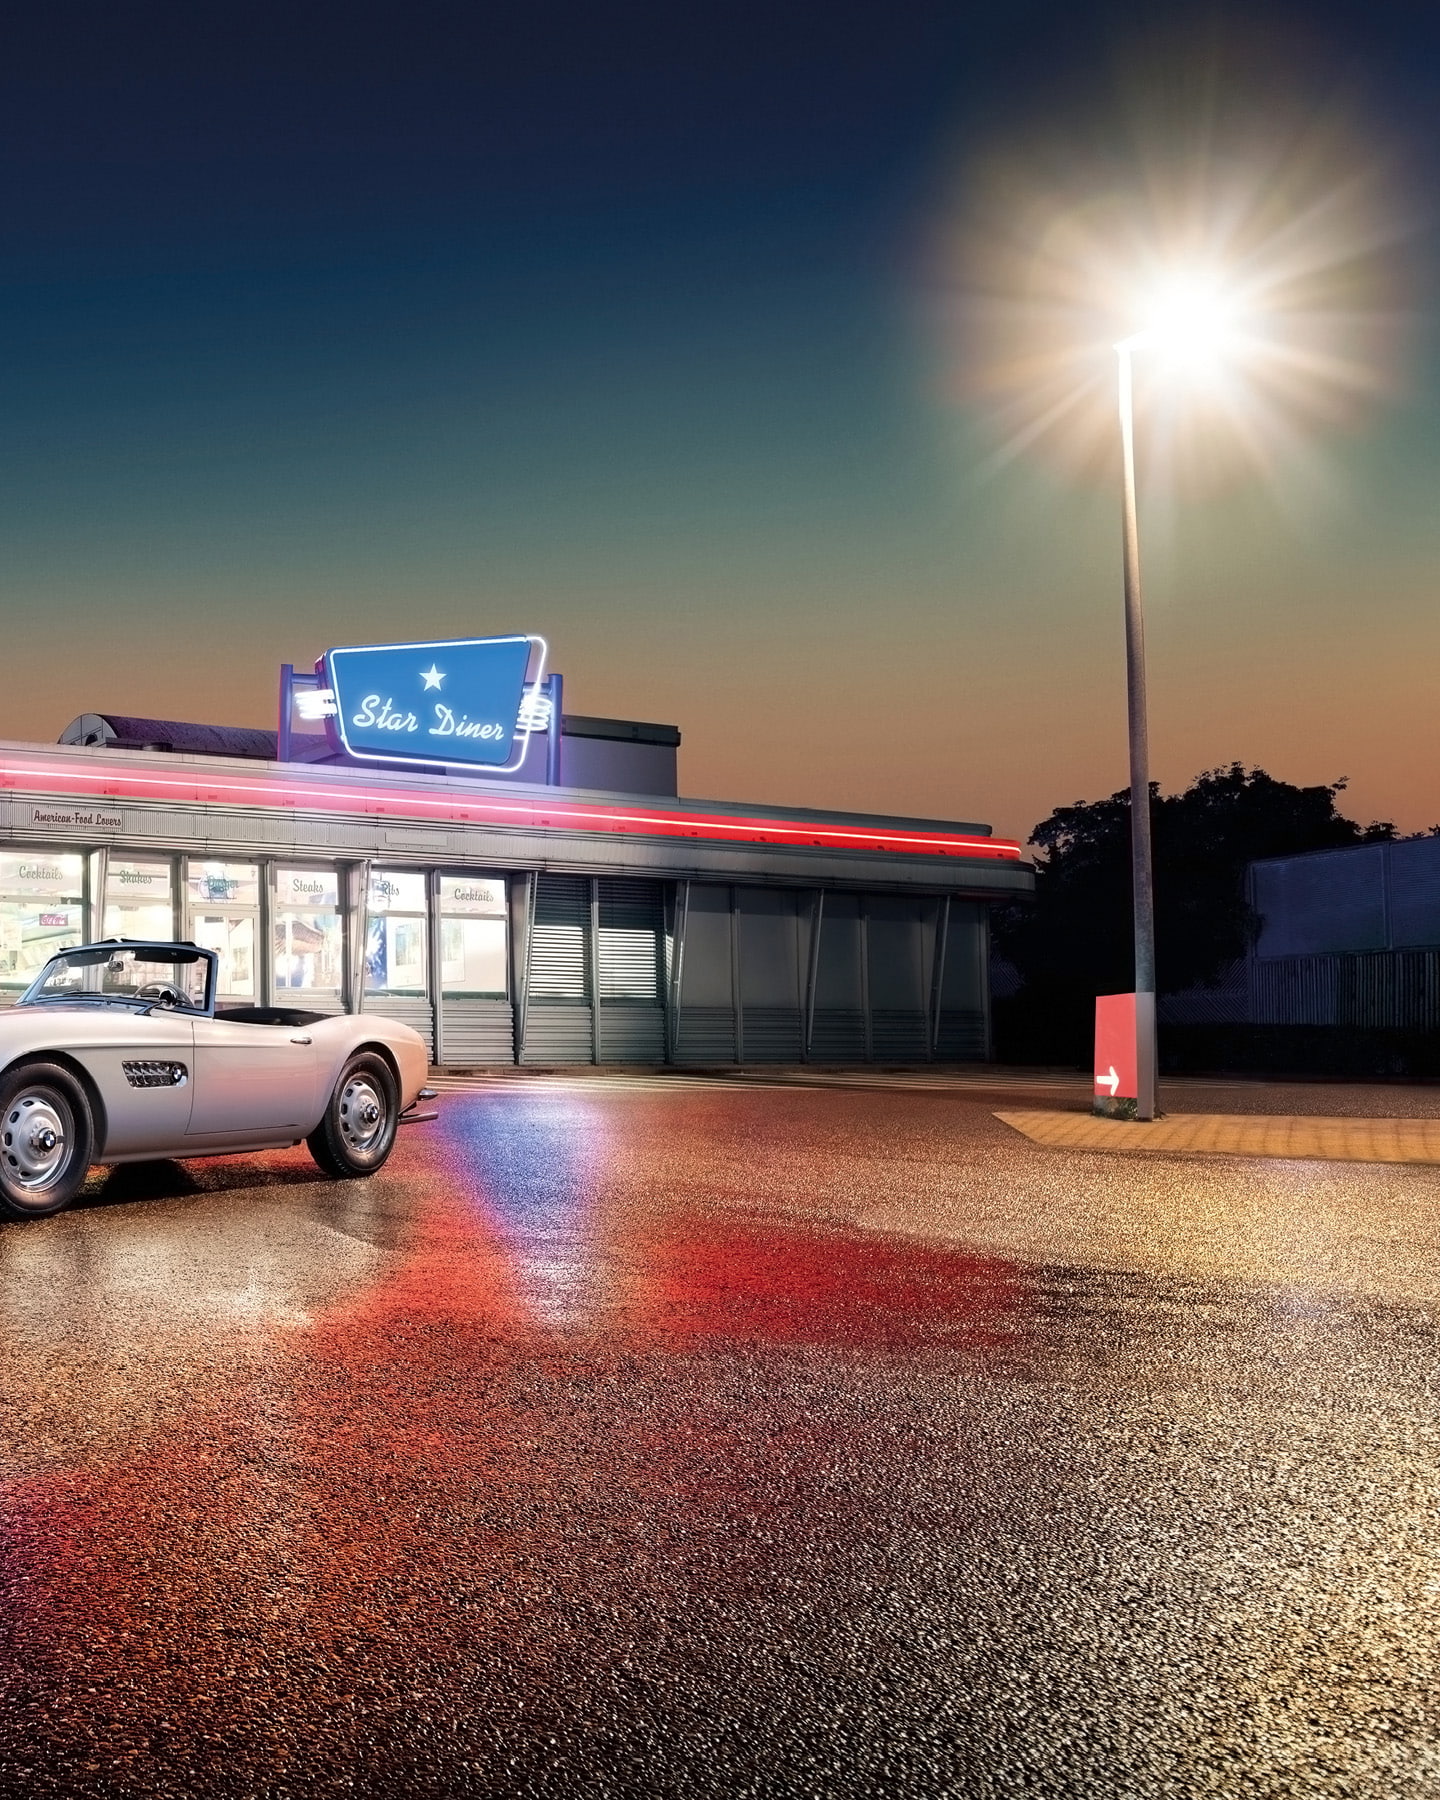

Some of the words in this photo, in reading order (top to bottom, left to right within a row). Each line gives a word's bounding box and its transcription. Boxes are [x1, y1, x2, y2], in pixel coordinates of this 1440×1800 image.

[352, 694, 418, 732] Star
[429, 703, 505, 741] Diner
[33, 809, 93, 825] American-Food
[95, 813, 122, 827] Lovers
[19, 864, 63, 880] Cocktails
[119, 870, 152, 885] Shakes
[292, 878, 324, 893] Steaks
[454, 887, 495, 903] Cocktails
